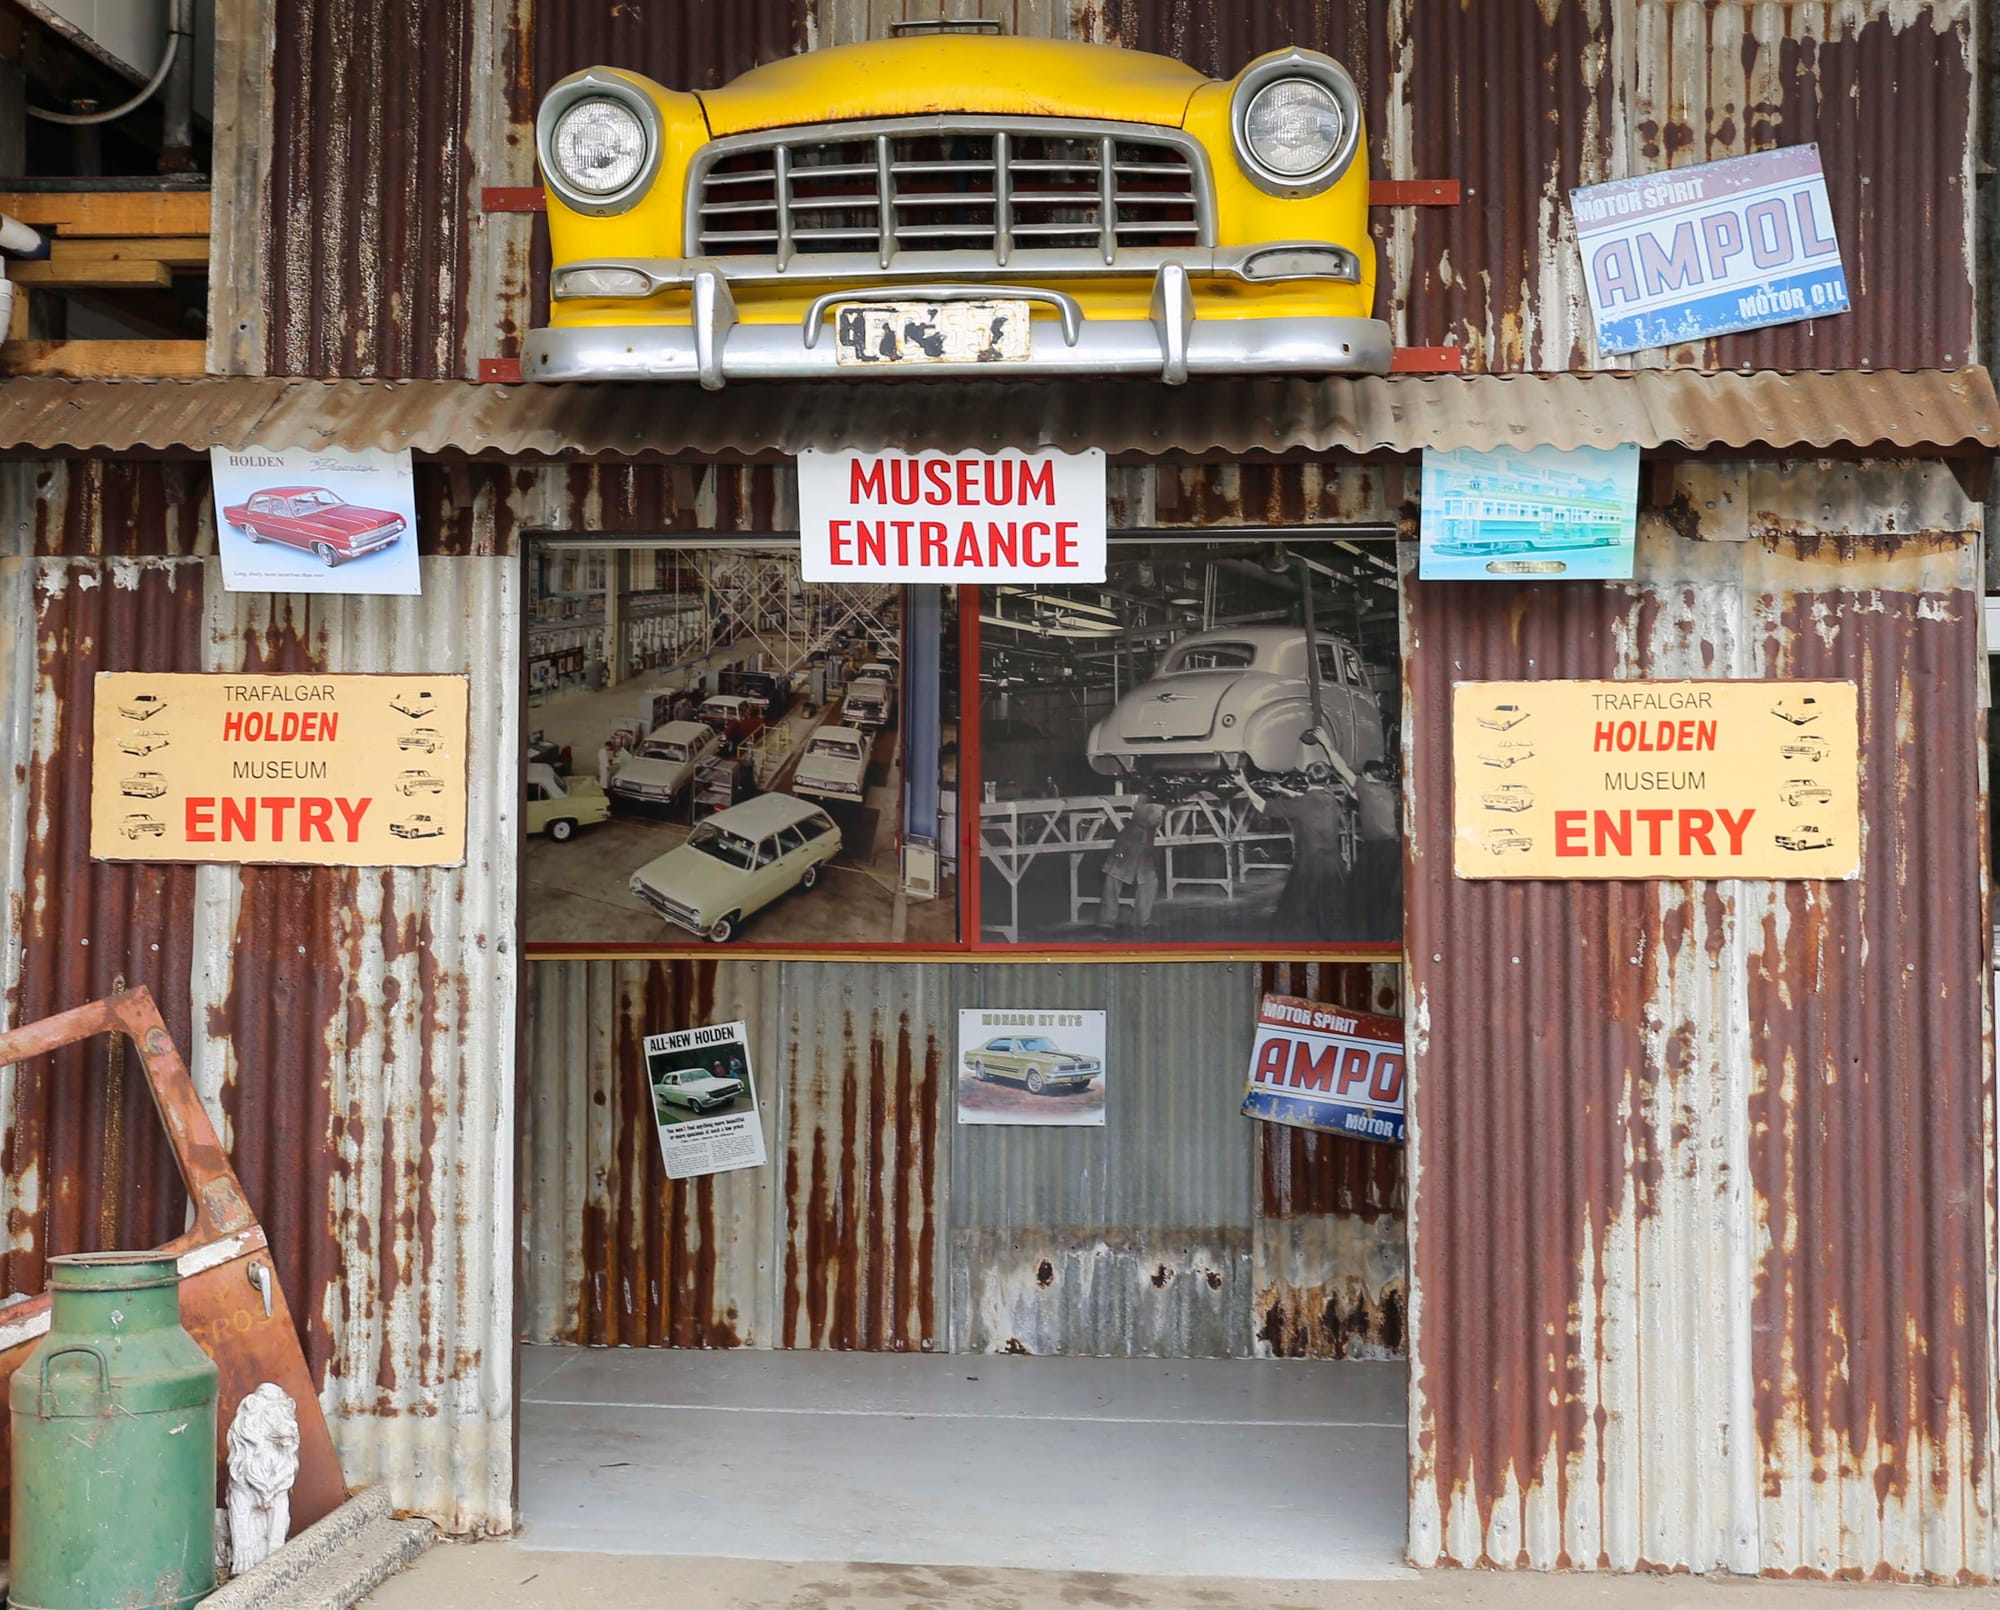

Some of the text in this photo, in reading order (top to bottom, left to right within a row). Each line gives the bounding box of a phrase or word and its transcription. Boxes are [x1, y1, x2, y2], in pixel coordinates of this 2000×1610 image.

[1577, 178, 1704, 222] MOTOR SPIRIT
[1592, 190, 1836, 309] AMPOL
[1738, 279, 1847, 319] MOTOR OIL
[229, 456, 285, 467] HOLDEN
[850, 458, 1056, 506] MUSEUM
[829, 520, 1079, 568] ENTRANCE
[224, 685, 336, 702] TRAFALGAR
[1592, 692, 1713, 710] TRAFALGAR
[223, 711, 339, 743] HOLDEN
[1593, 719, 1717, 752] HOLDEN
[232, 760, 328, 780] MUSEUM
[1604, 771, 1706, 791] MUSEUM
[185, 796, 373, 843] ENTRY
[1554, 808, 1756, 857] ENTRY
[1263, 1002, 1358, 1035] MOTOR SPIRIT
[650, 1026, 735, 1052] ALL-NEW HOLDEN
[1345, 1112, 1398, 1137] MOTOR
